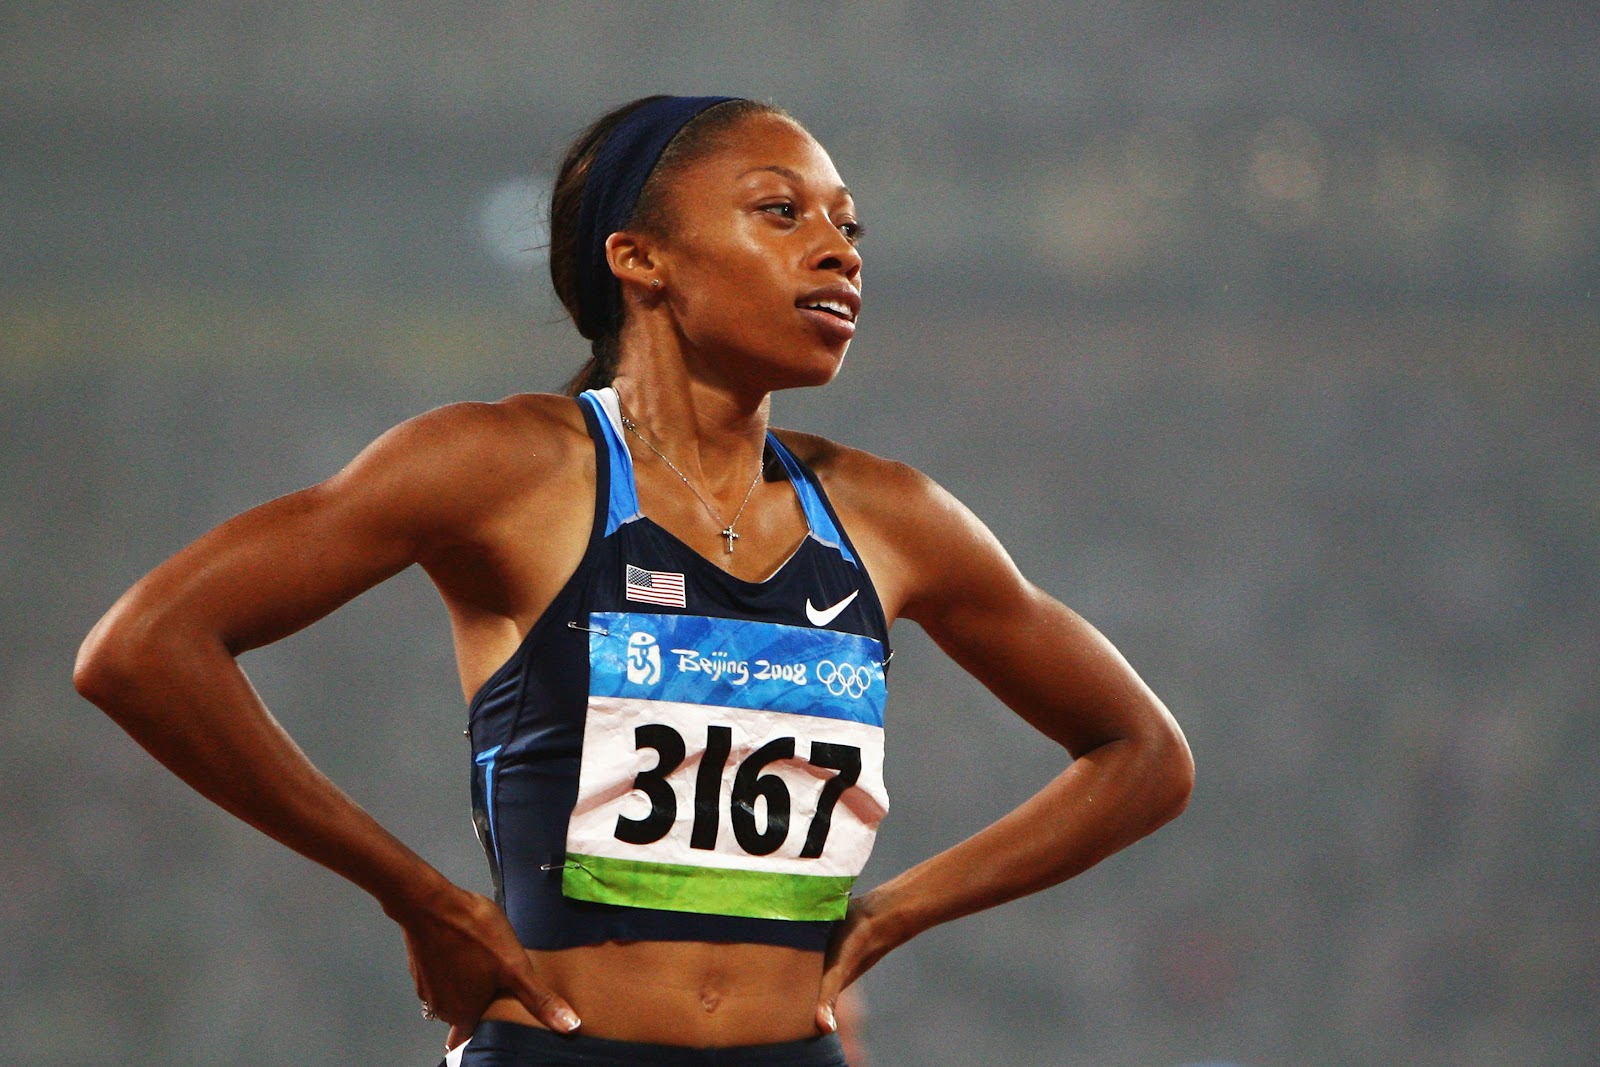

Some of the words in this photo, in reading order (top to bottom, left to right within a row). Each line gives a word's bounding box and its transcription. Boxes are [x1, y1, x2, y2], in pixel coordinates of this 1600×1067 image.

[670, 649, 750, 685] Beijing
[753, 660, 807, 685] 2008
[614, 723, 862, 859] 3167
